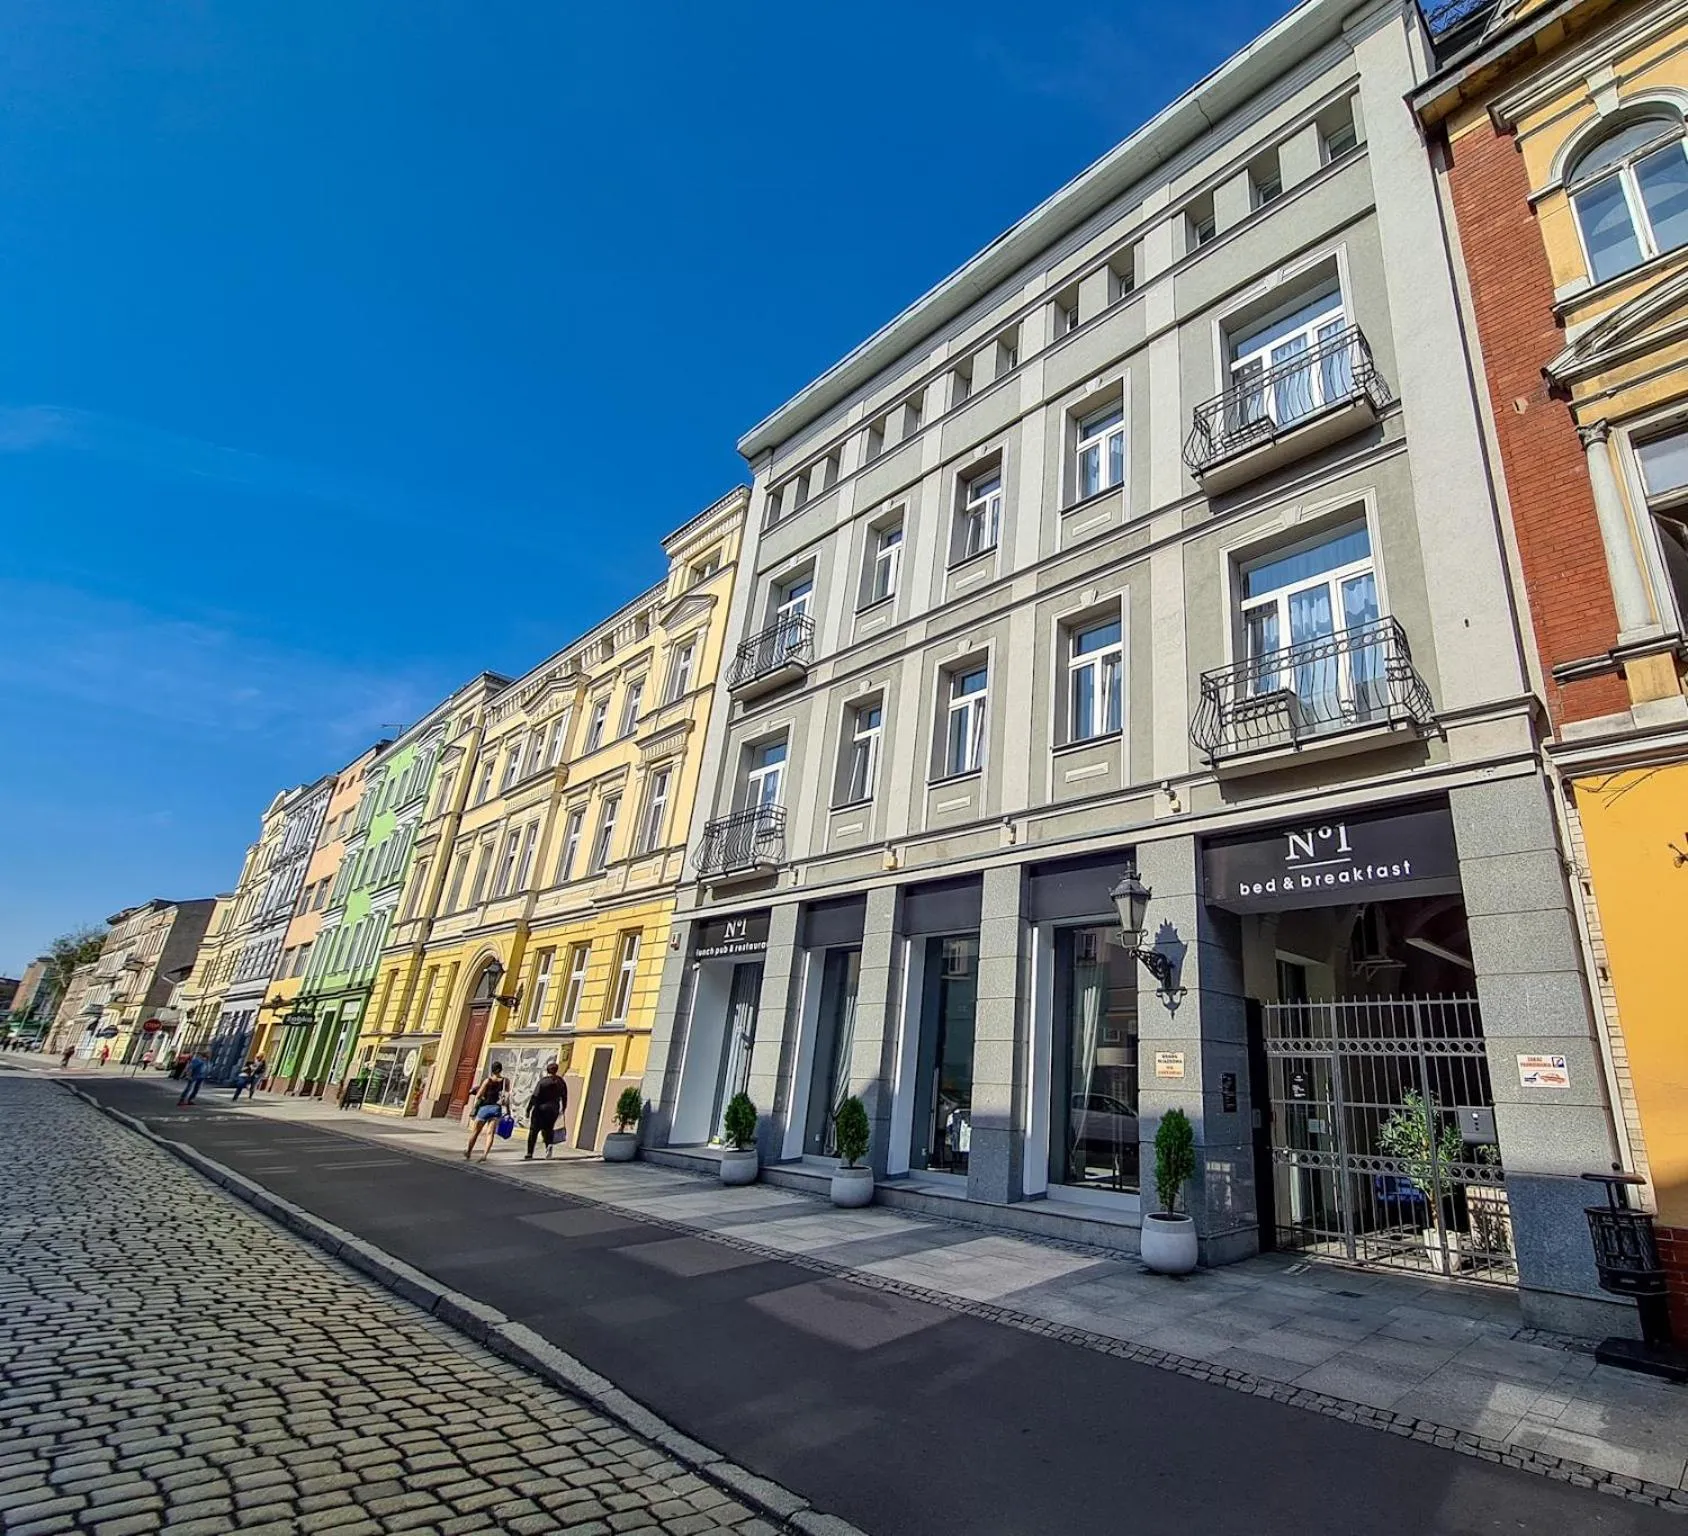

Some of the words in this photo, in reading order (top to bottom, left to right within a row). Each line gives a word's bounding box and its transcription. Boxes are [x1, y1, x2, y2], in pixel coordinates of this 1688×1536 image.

[1239, 878, 1276, 896] bed
[1283, 876, 1294, 890] &
[1300, 860, 1411, 888] breakfast
[695, 947, 714, 957] lunch
[714, 945, 728, 956] pub
[729, 944, 734, 953] &
[735, 941, 767, 953] restaura
